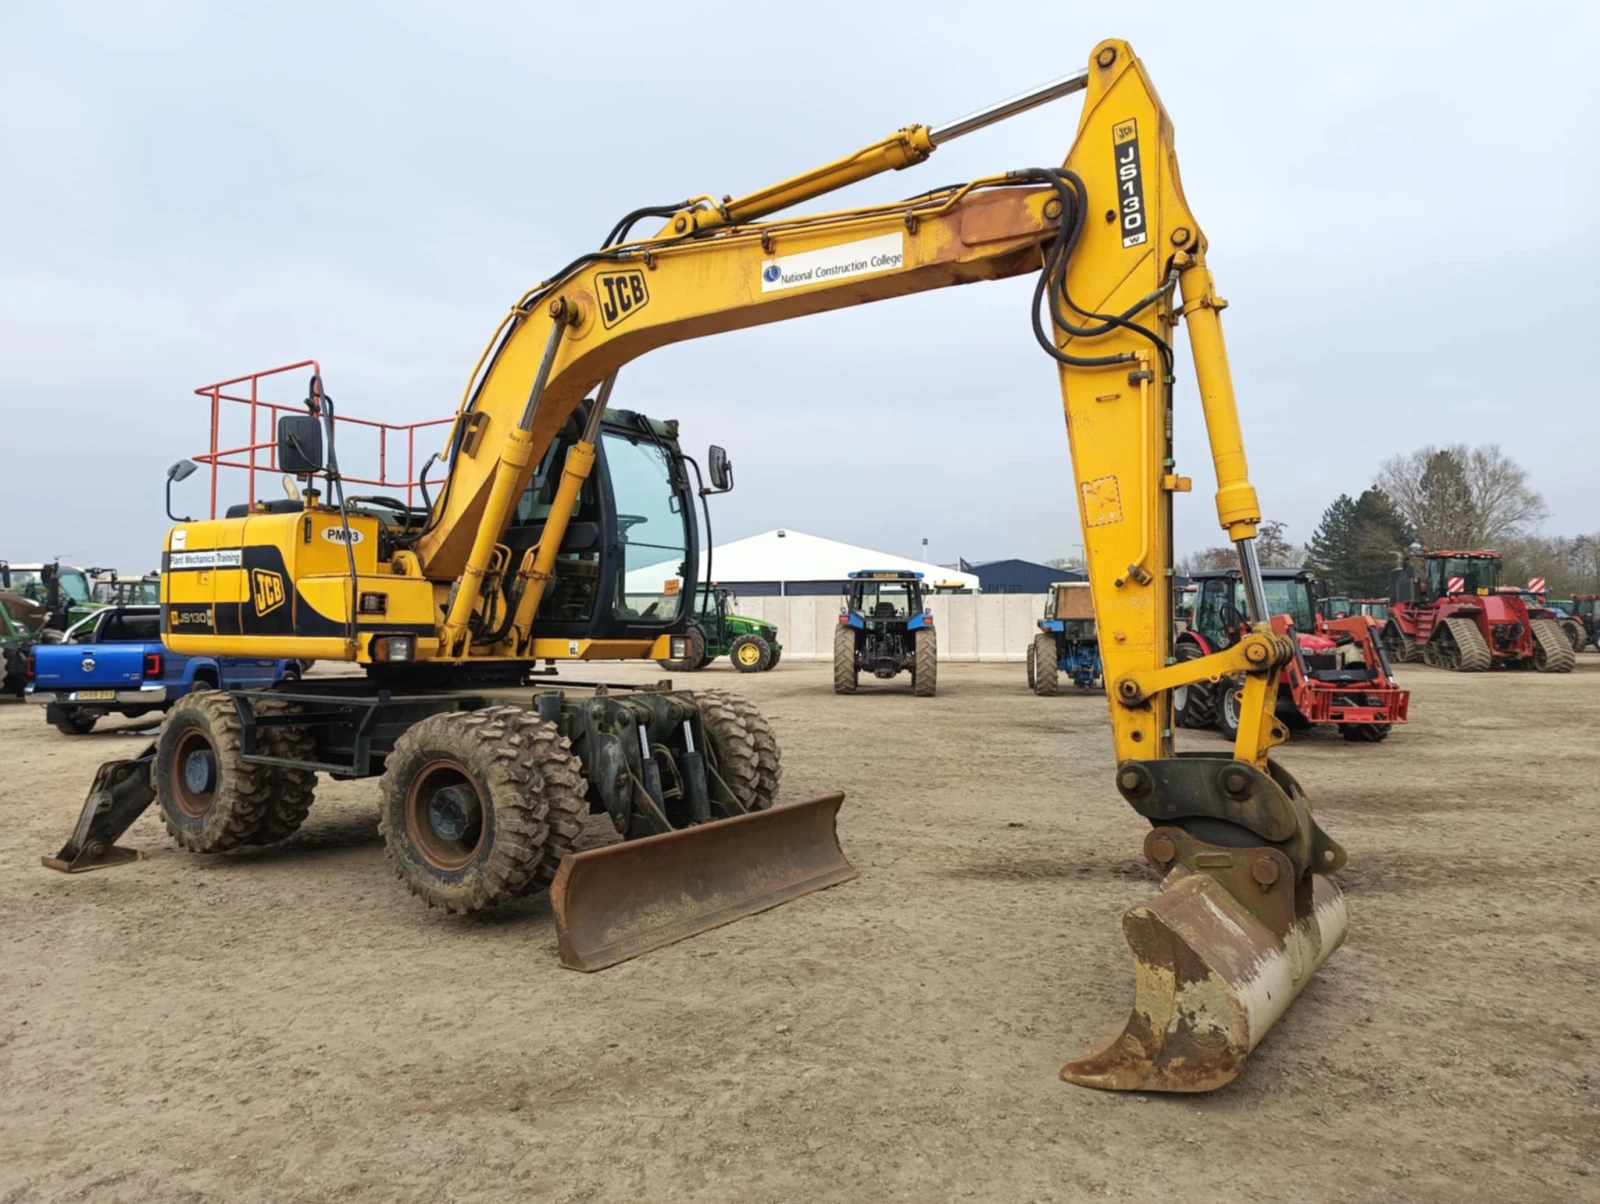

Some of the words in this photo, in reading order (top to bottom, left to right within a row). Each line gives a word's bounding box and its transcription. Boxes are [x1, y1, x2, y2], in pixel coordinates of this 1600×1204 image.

[1118, 126, 1133, 138] JCB
[1120, 147, 1141, 229] JS130
[781, 269, 813, 284] National
[816, 260, 868, 278] Construction
[870, 254, 902, 267] College
[603, 275, 645, 322] JCB
[170, 555, 184, 564] Plant
[185, 554, 215, 564] Mechanics
[216, 552, 240, 564] Training
[256, 573, 282, 611] JCB
[179, 611, 207, 624] JS130
